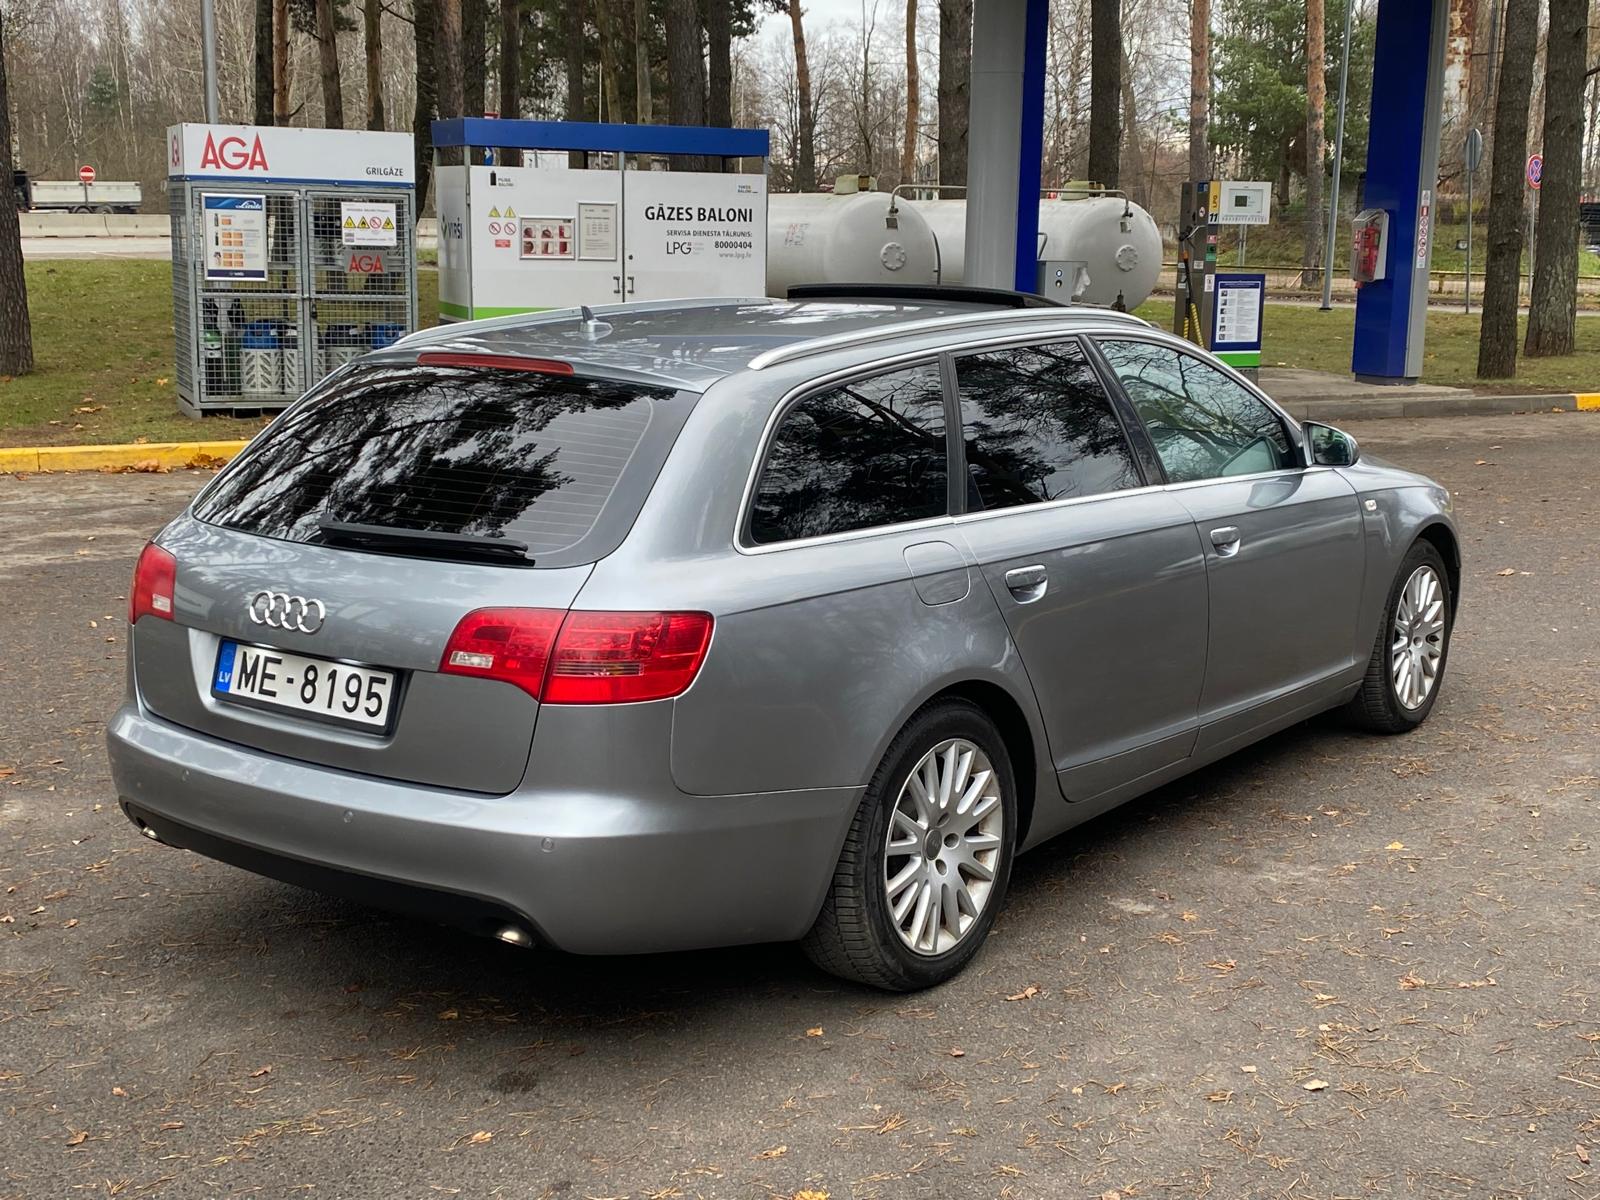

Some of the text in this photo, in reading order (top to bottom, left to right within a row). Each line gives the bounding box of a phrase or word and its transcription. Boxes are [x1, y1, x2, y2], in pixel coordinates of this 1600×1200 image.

[200, 130, 269, 171] AGA
[366, 166, 403, 176] GRILGĀZE
[645, 203, 753, 222] GĀZES BALONI
[1209, 213, 1218, 222] 11
[666, 229, 691, 237] SERVISA
[722, 230, 753, 238] TĀLRUNIS:
[666, 241, 692, 255] LPG
[714, 241, 752, 249] 80000404
[349, 253, 384, 272] AGA
[218, 671, 231, 683] LV
[237, 651, 387, 718] ME-8195
